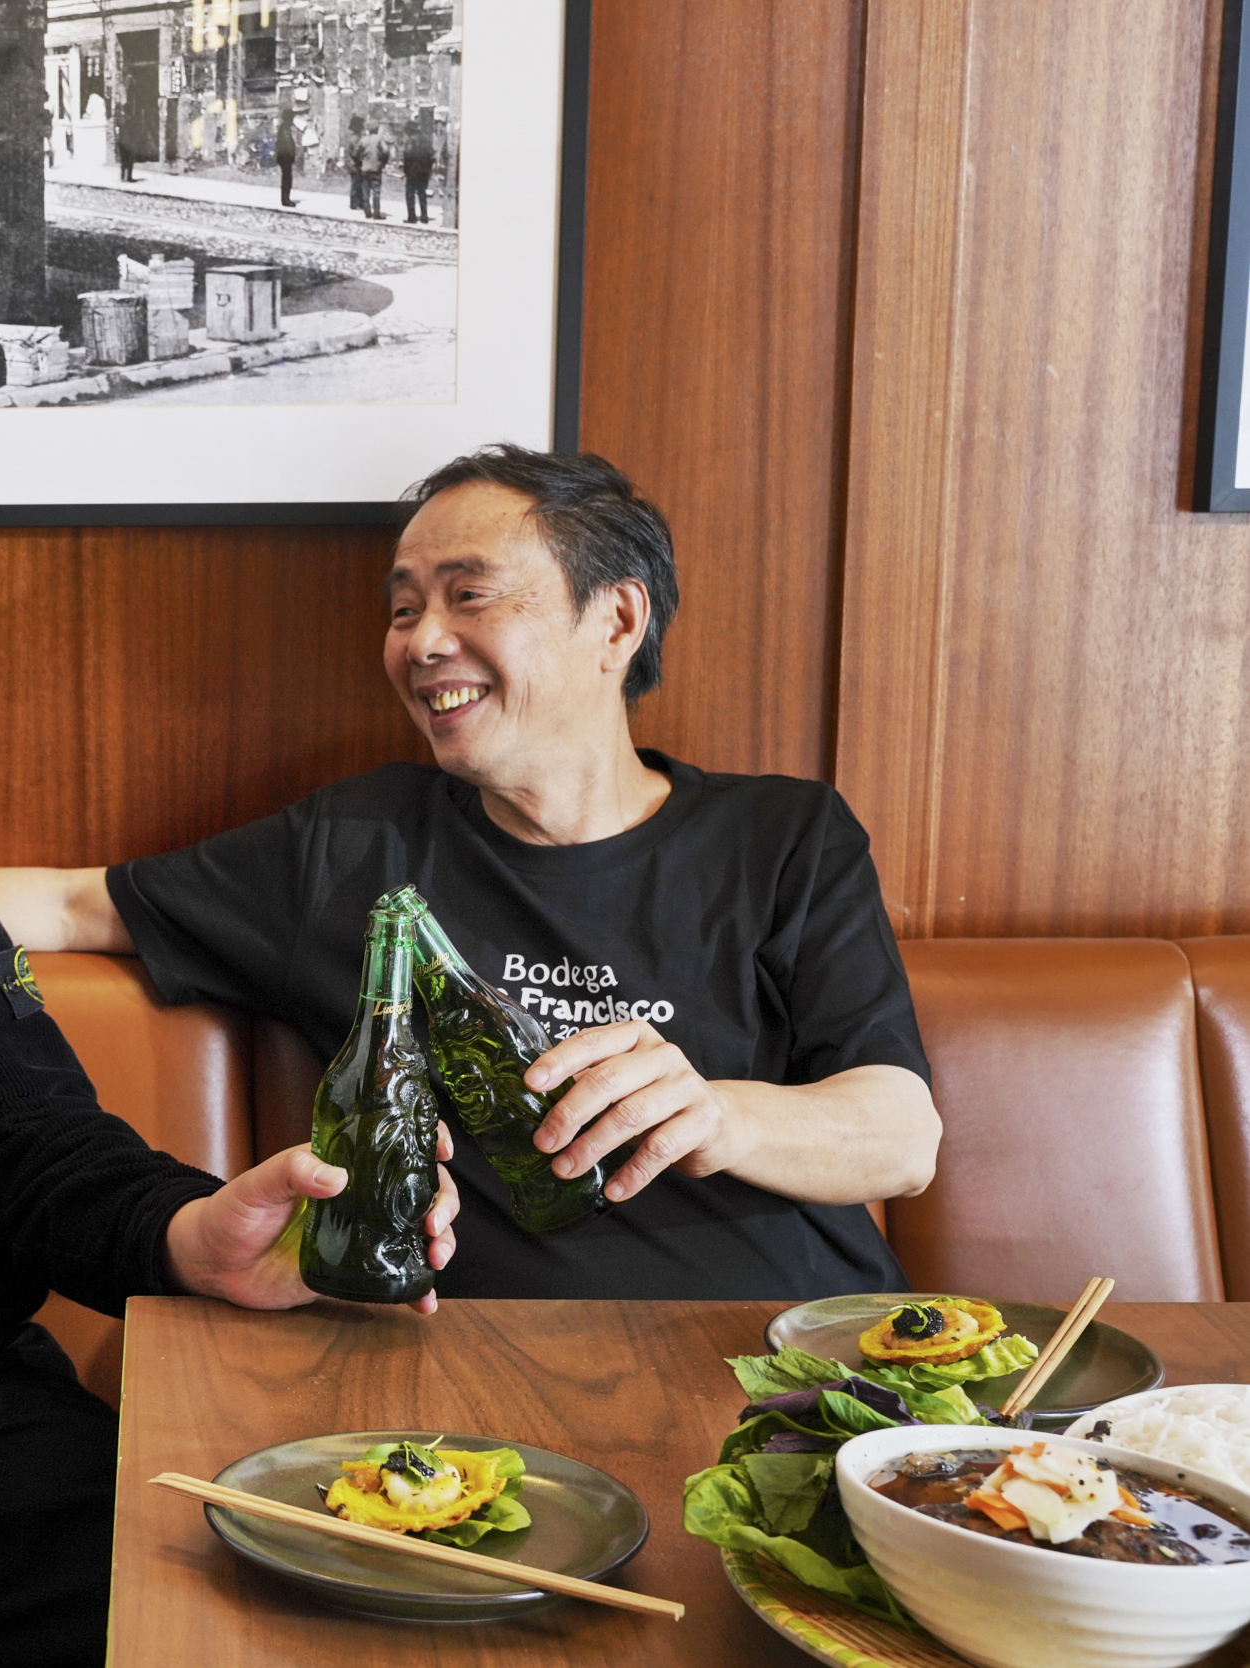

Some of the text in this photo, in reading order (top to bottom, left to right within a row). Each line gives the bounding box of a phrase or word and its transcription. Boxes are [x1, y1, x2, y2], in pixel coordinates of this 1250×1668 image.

[502, 954, 618, 993] Bodega
[521, 987, 674, 1023] Francisco
[554, 1024, 588, 1040] 20
